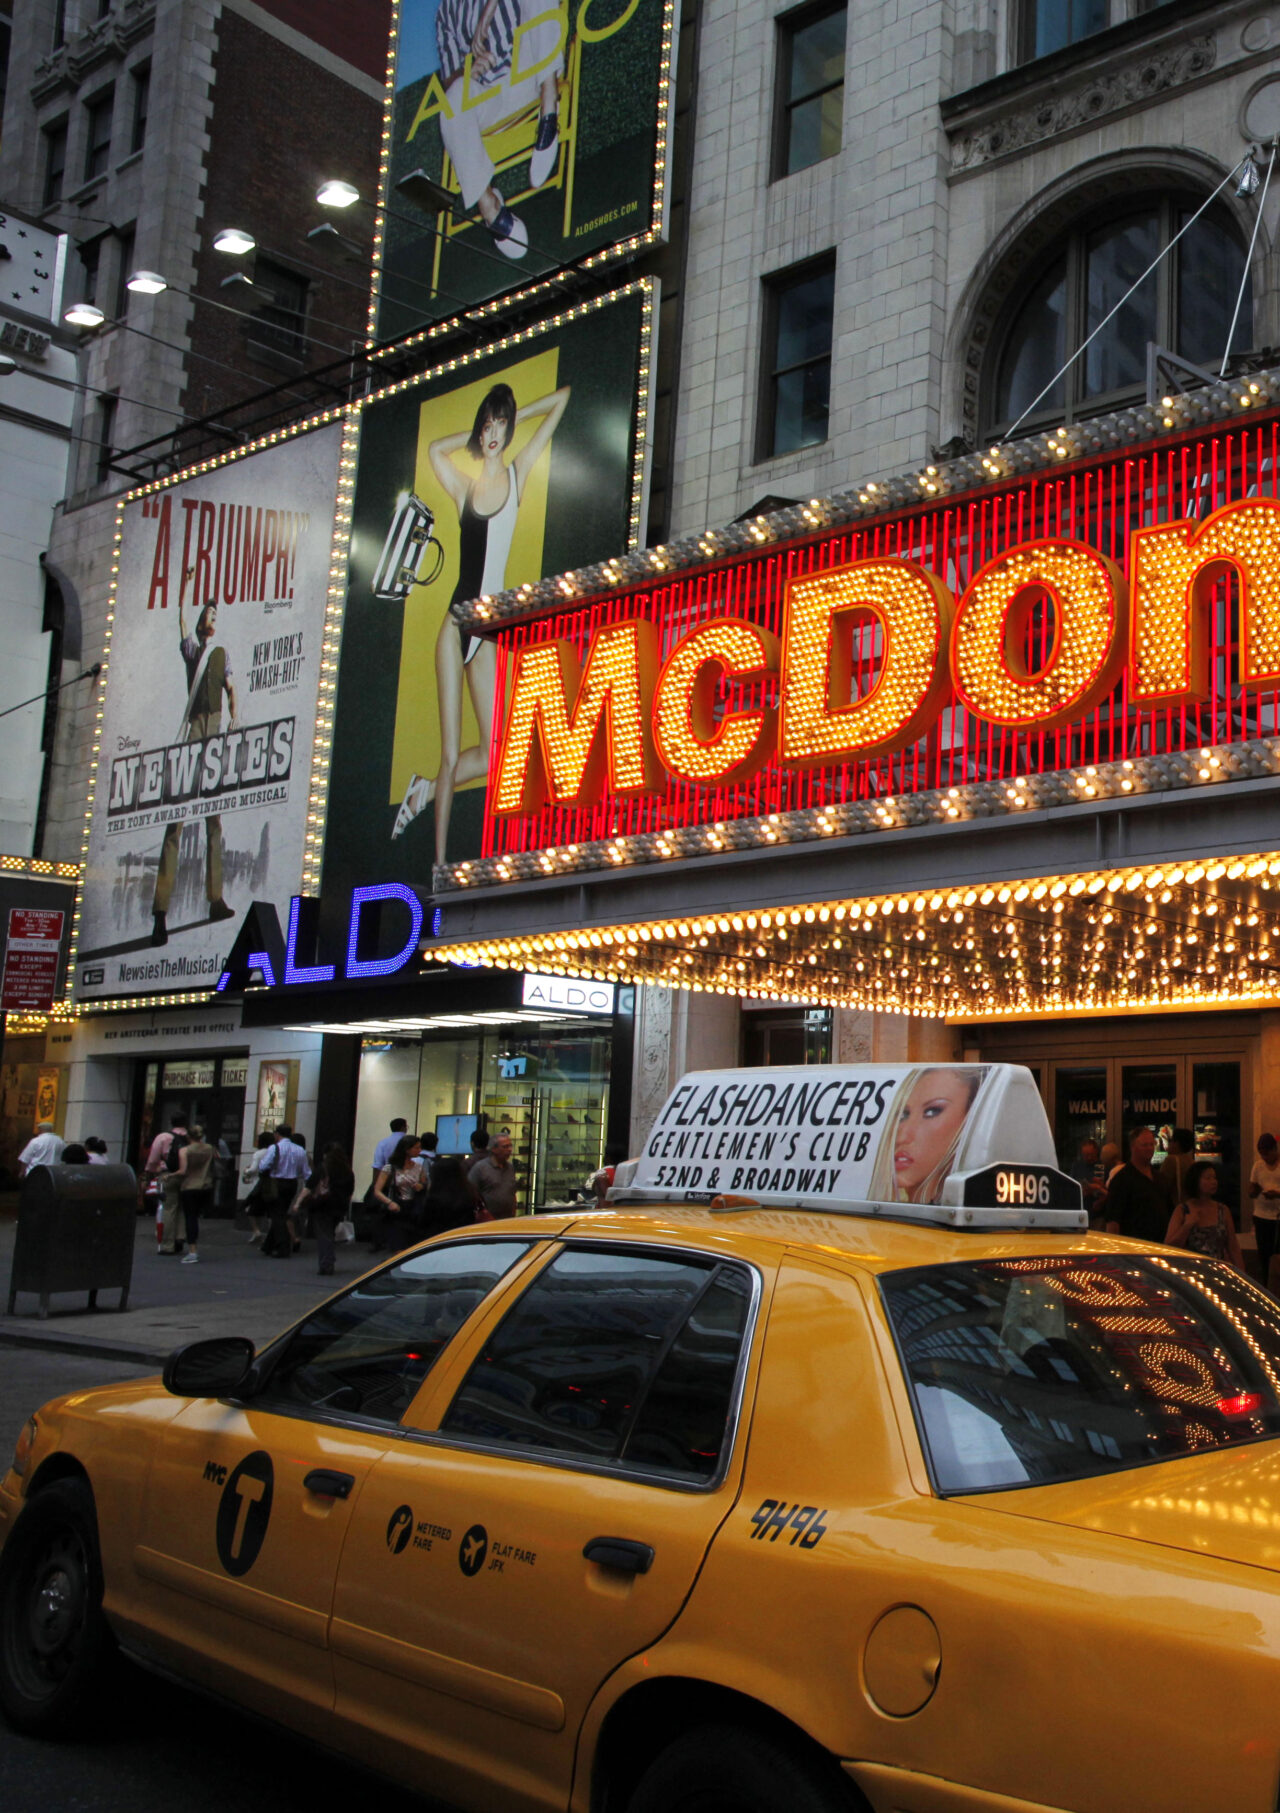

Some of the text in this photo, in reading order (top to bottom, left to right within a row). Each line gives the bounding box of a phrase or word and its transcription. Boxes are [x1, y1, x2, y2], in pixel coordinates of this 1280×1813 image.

[405, 0, 640, 143] ALDO
[575, 201, 638, 237] ALDOSHOES.COM
[34, 268, 49, 280] 3
[142, 493, 311, 610] “A TRIUMPH!”
[264, 601, 293, 610] Bloomberg
[253, 632, 303, 667] NEW YORK'S
[246, 656, 306, 693] “SMASH-HIT!”
[117, 735, 142, 751] Disney
[109, 719, 294, 811] NEWSIES
[107, 818, 126, 833] THE
[128, 814, 152, 829] TONY
[239, 786, 287, 807] MUSICAL
[217, 882, 441, 991] ALD
[118, 953, 228, 983] NewsiesTheMusical.c
[528, 985, 609, 1008] ALDO
[164, 1071, 196, 1085] PURCHASE
[660, 1079, 897, 1127] FLASHDANCERS
[1068, 1100, 1106, 1114] WALK
[1134, 1099, 1177, 1113] WINDO
[648, 1131, 872, 1162] GENTLEMEN'S CLUB
[653, 1166, 842, 1193] 52ND & BROADWAY
[995, 1171, 1050, 1205] 9H96
[203, 1461, 228, 1486] NYC
[230, 1473, 267, 1560] T
[416, 1521, 452, 1541] METERED
[750, 1499, 828, 1549] 9H96
[413, 1536, 433, 1551] FARE
[491, 1542, 537, 1565] FLAT FARE
[488, 1559, 505, 1573] JFK
